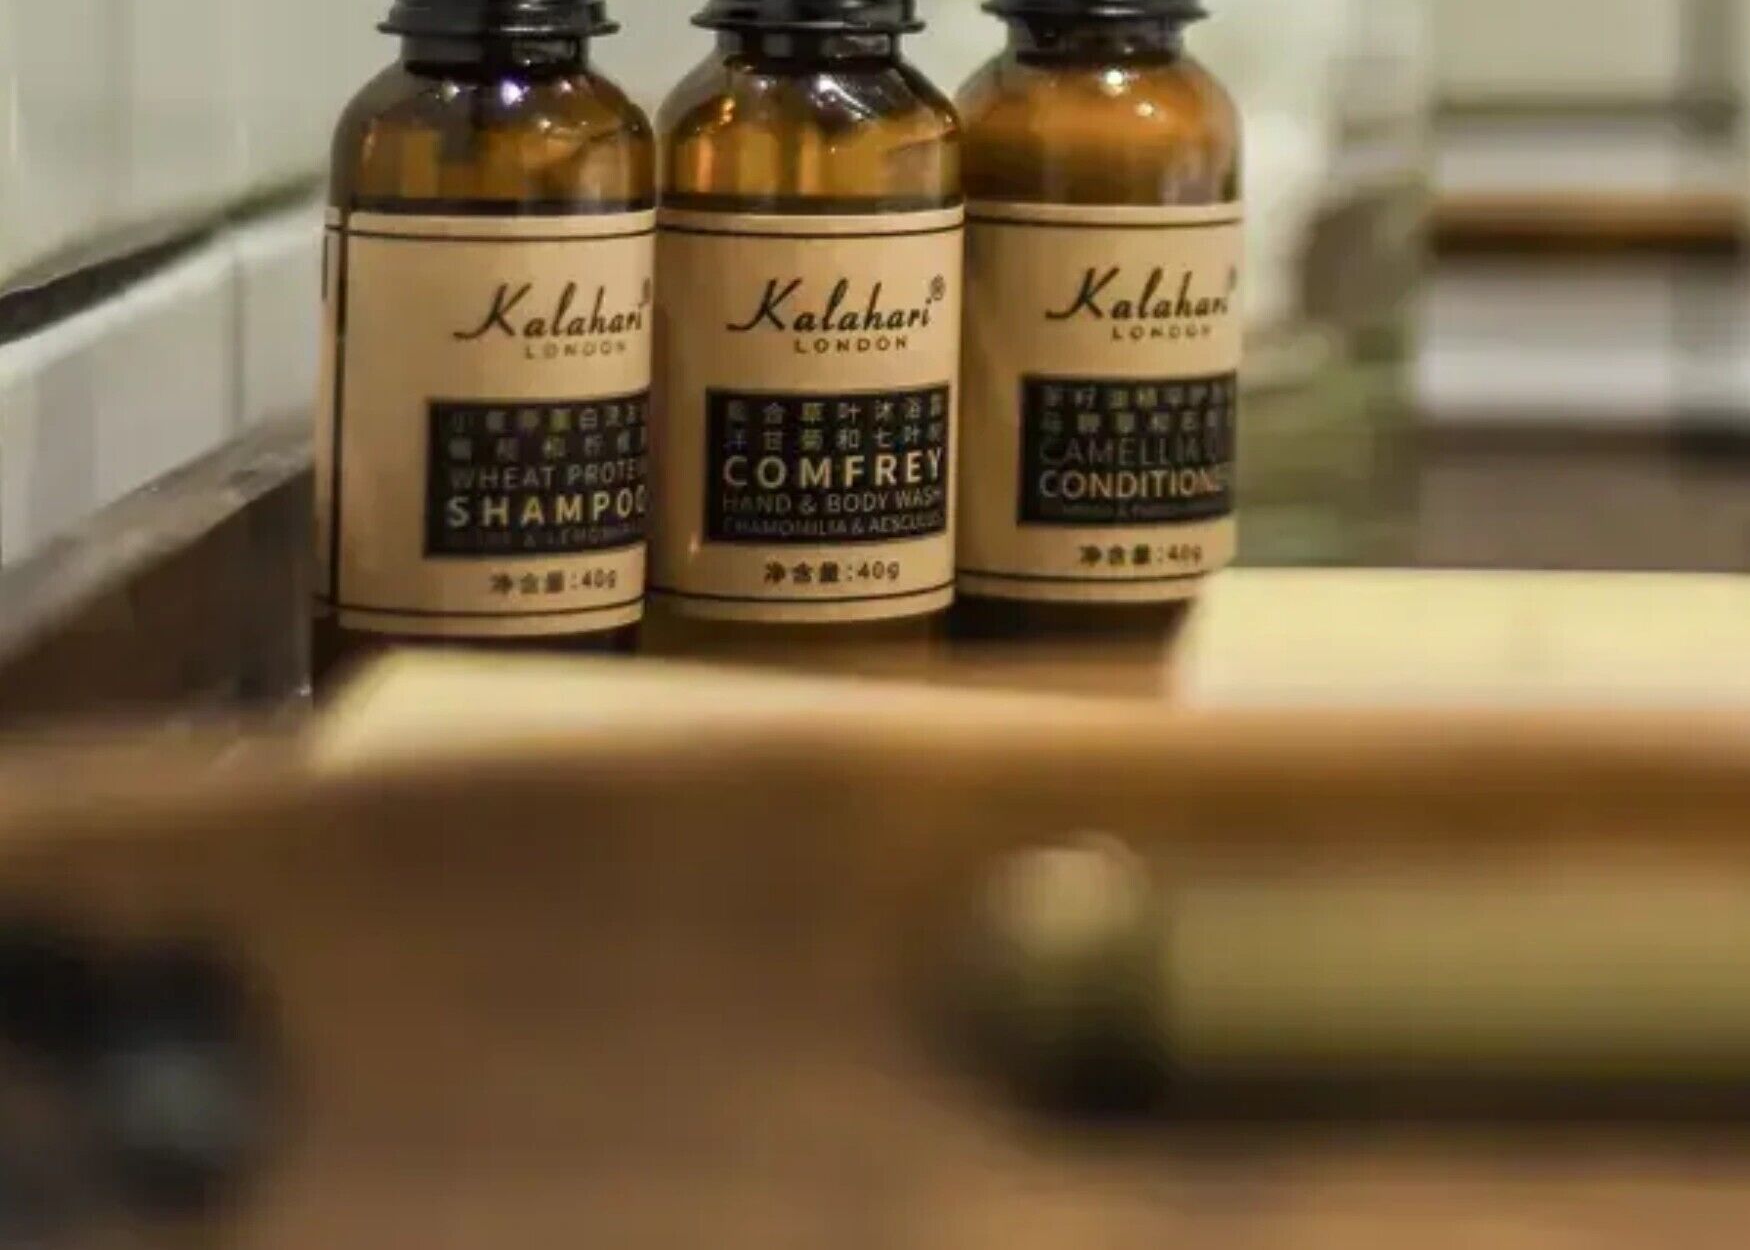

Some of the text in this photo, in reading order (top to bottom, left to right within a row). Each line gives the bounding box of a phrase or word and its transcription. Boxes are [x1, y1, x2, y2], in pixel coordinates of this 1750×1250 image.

[793, 334, 909, 355] LONDON
[722, 447, 944, 489] COMFREY
[722, 493, 792, 514] HAND
[826, 491, 889, 514] BODY
